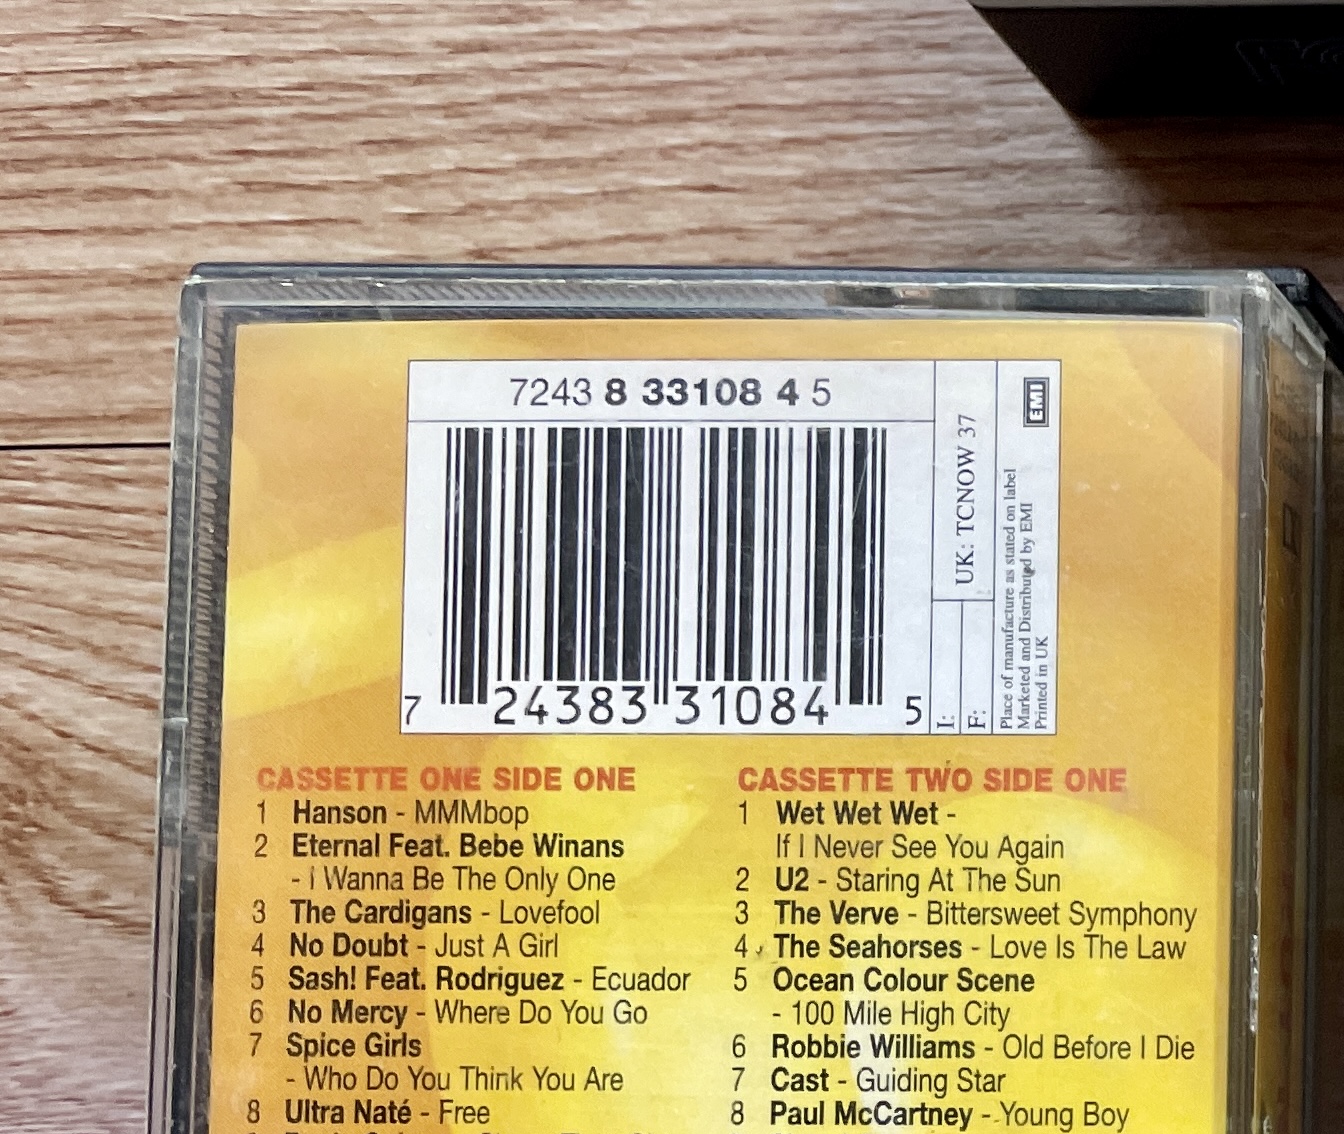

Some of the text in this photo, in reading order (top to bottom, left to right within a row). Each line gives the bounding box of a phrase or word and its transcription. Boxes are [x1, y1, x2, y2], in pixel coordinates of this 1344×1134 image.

[510, 378, 830, 406] 7243 8 33108 4 5
[1031, 385, 1042, 419] EMI
[956, 415, 976, 585] UK: TCNOW 37
[1036, 637, 1048, 658] UK
[405, 686, 921, 725] 7 24383 31084 5
[1035, 682, 1047, 729] Printed
[257, 766, 635, 791] CASSETTE ONE SIDE ONE
[739, 767, 1126, 792] CASSETTE TWO SIDE ONE
[255, 833, 624, 857] 2 Eternal Feat. Bebe Winans
[734, 967, 1034, 992] 5 Ocean Colour Scene
